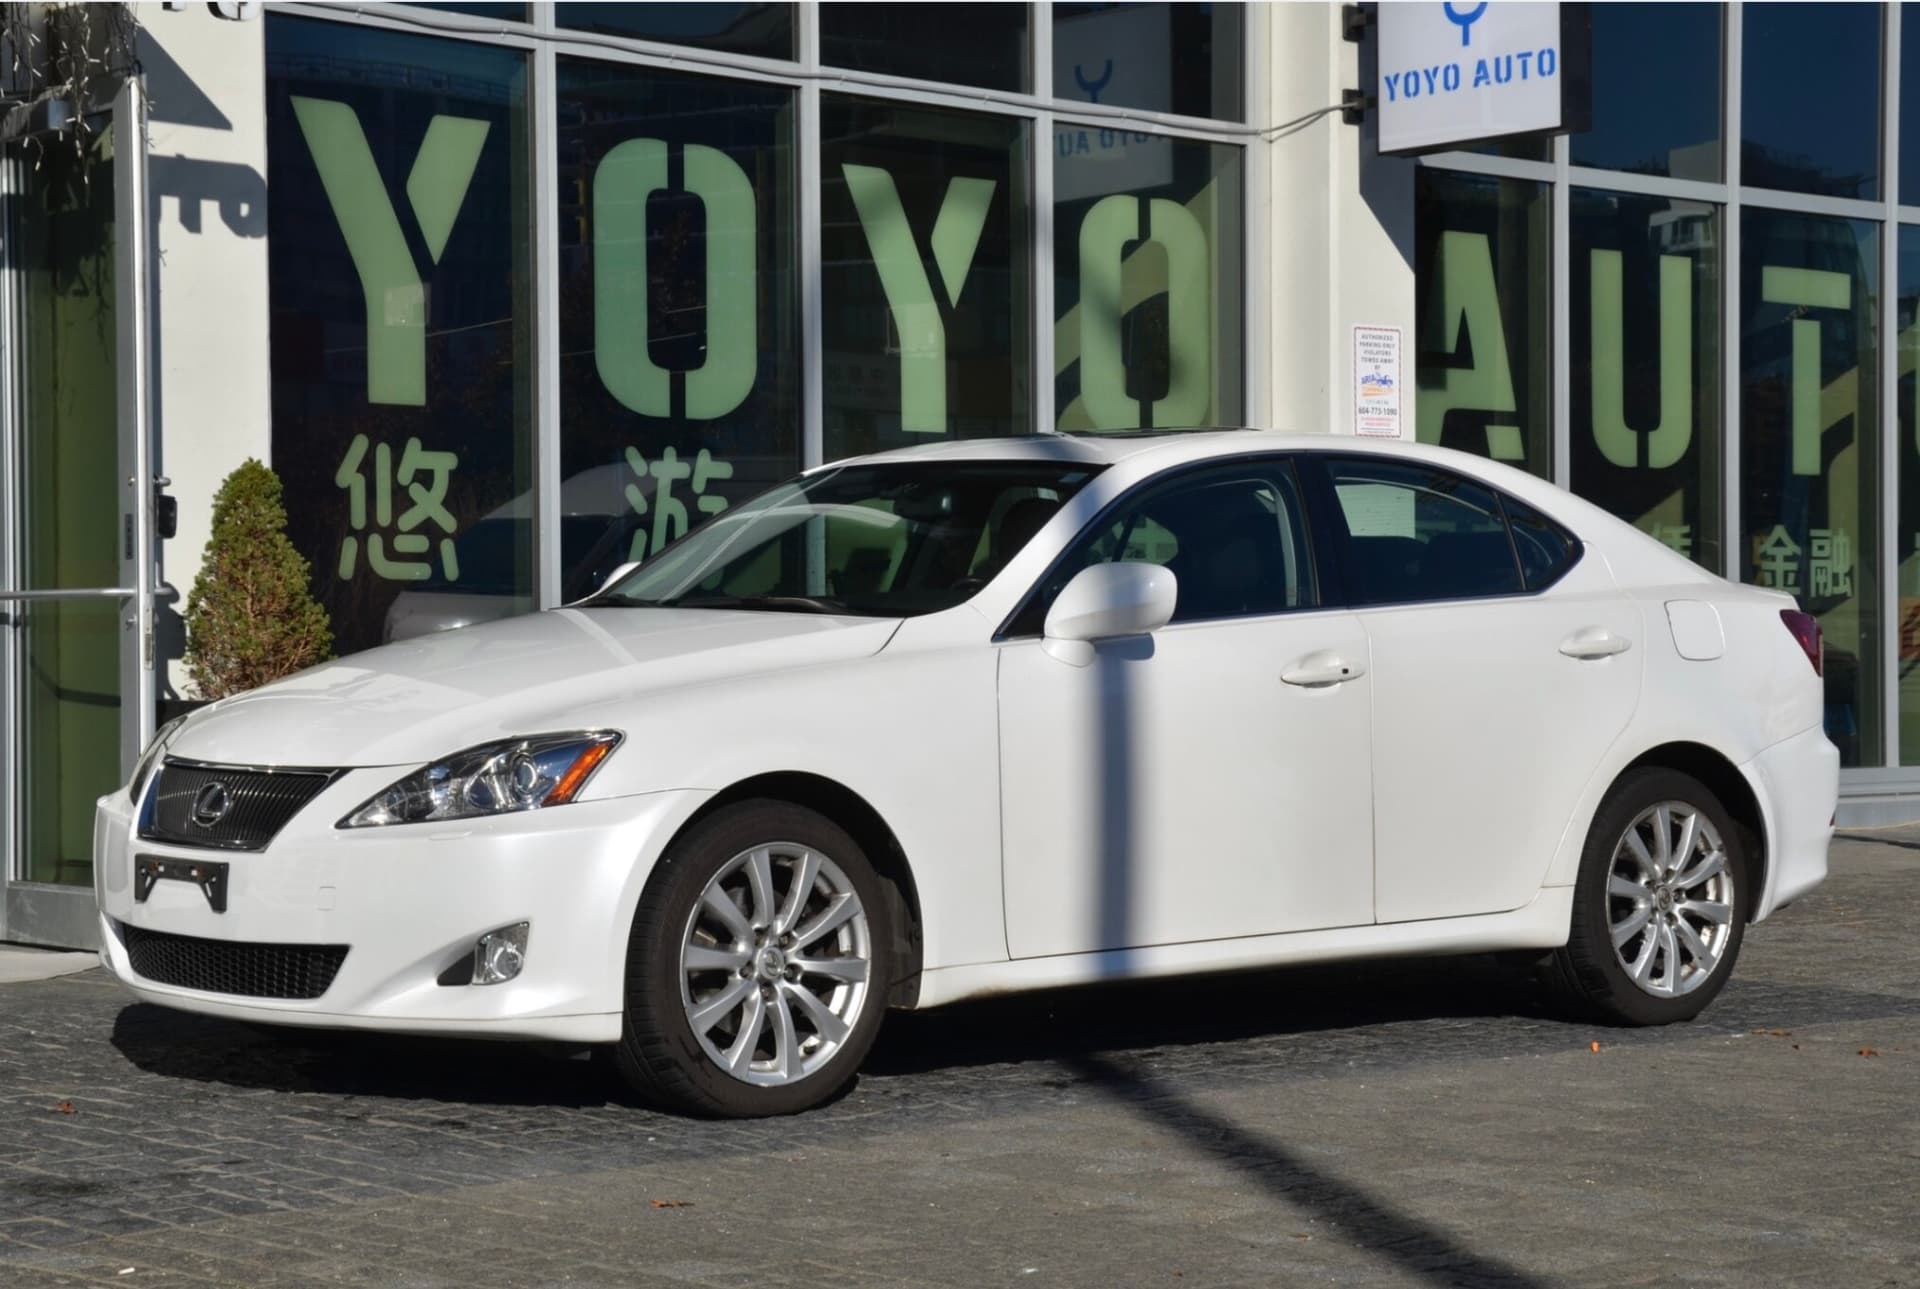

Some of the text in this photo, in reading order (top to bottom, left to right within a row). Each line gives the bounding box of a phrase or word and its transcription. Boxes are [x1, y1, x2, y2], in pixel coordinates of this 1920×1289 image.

[1384, 47, 1556, 102] YOYO AUTO
[290, 96, 1208, 434] YOYO
[1415, 231, 1920, 476] AUT
[1760, 523, 1854, 598] 金融
